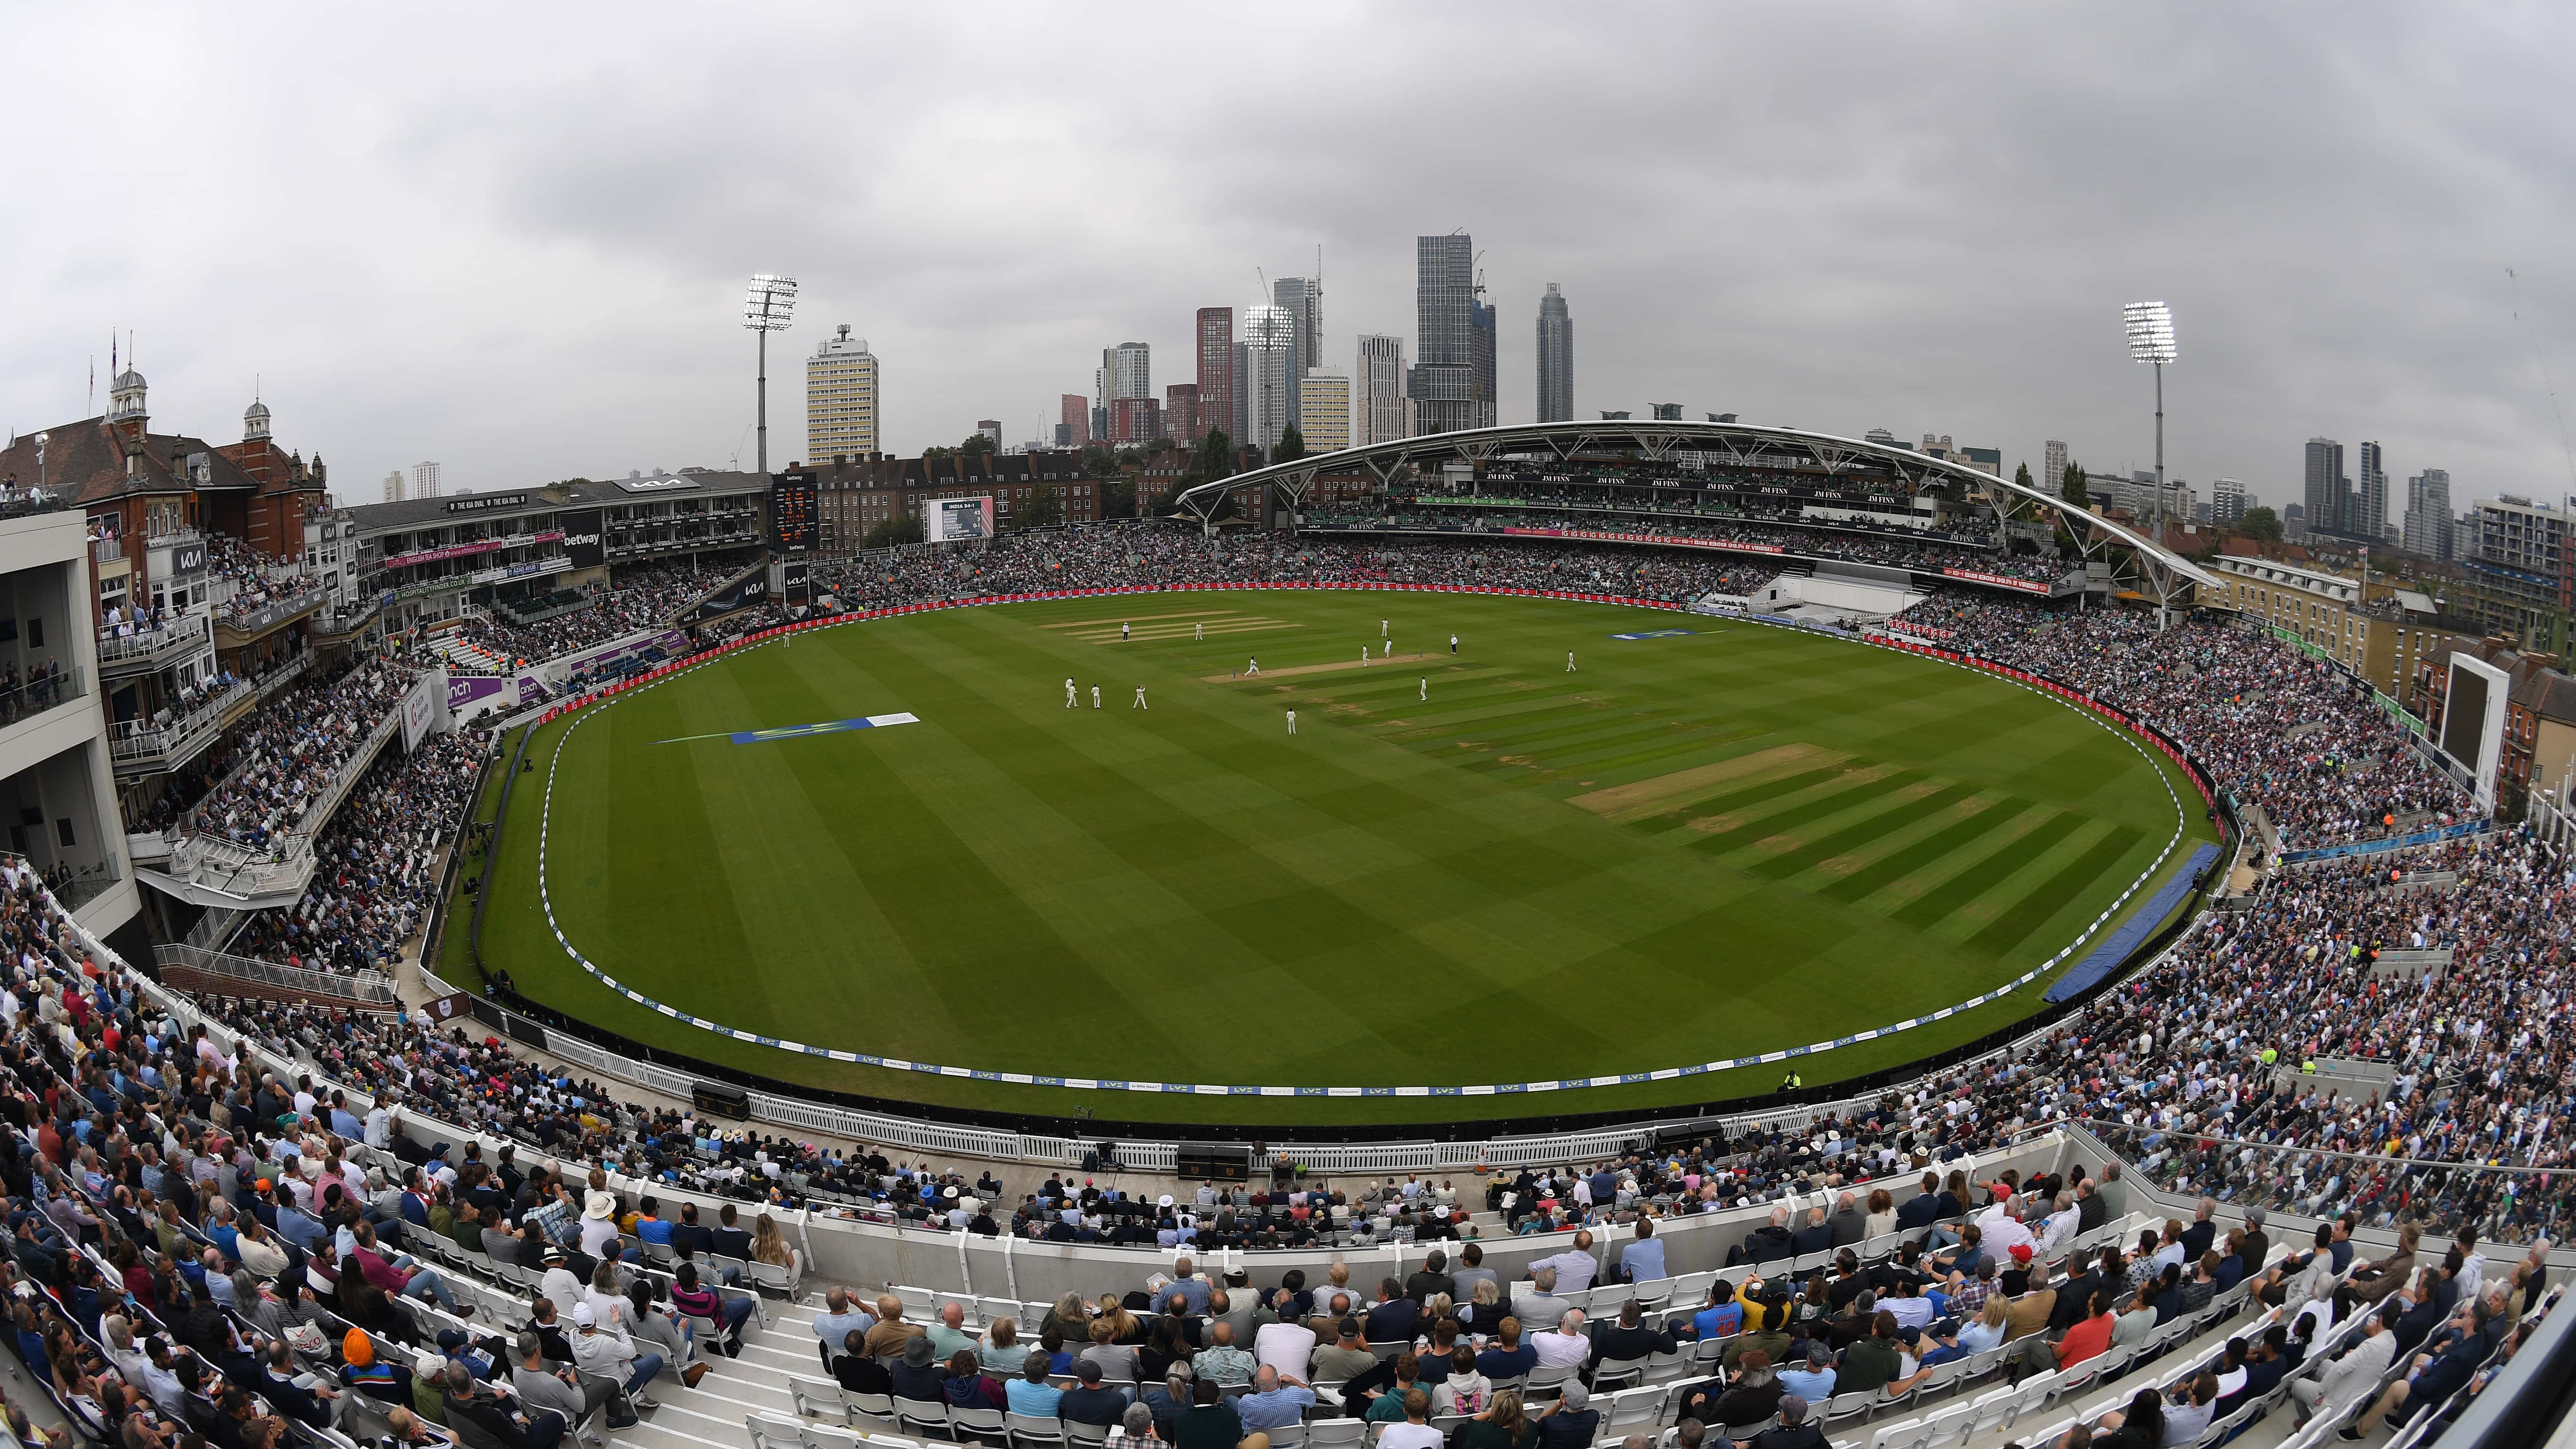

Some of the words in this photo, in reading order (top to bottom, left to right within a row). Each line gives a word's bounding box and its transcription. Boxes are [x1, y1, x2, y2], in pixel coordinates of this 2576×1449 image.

[631, 479, 681, 488] KIA
[325, 527, 335, 538] KIA
[564, 534, 599, 546] betway
[181, 550, 201, 569] KIA
[406, 554, 425, 564] ENGLISH
[425, 553, 433, 561] TEA
[433, 551, 445, 560] SHOP
[513, 566, 526, 574] AZAD
[327, 575, 336, 588] KIA
[787, 577, 806, 585] KIA
[401, 580, 465, 598] HOSPITALITYFINDER.CO.UK
[745, 582, 763, 595] KIA
[261, 614, 271, 624] KIA
[1755, 614, 1791, 624] LV.com/insurance
[2242, 614, 2255, 623] GREENE
[652, 636, 663, 644] cinch
[620, 647, 631, 655] cinch
[584, 659, 596, 667] cinch
[448, 681, 471, 699] inch
[520, 681, 537, 693] cinch
[592, 693, 597, 702] IG
[572, 701, 577, 710] IG
[410, 703, 417, 729] IG
[2417, 738, 2424, 751] JM
[2423, 742, 2434, 758] FINN
[716, 1025, 728, 1033] LV=
[1716, 1312, 1736, 1322] VIRAT
